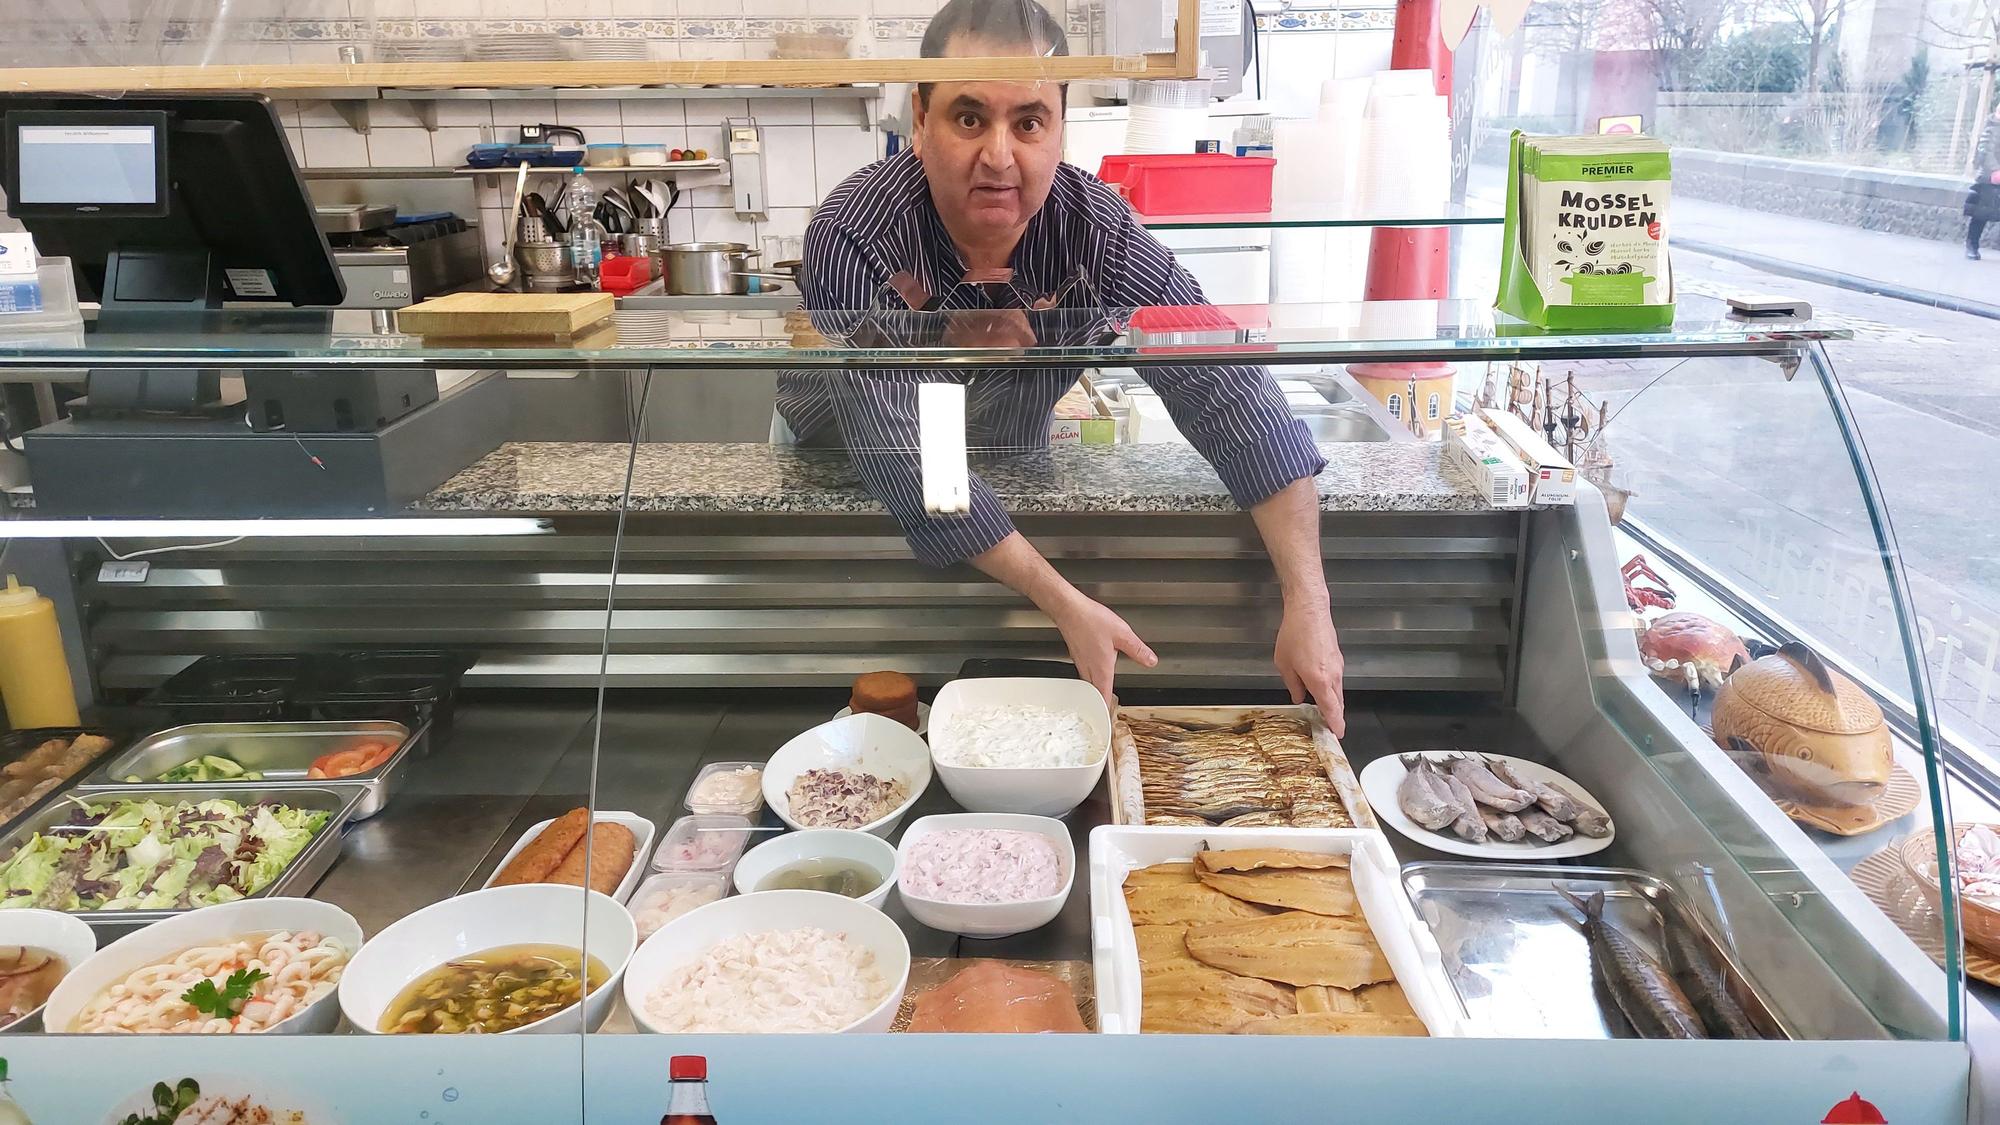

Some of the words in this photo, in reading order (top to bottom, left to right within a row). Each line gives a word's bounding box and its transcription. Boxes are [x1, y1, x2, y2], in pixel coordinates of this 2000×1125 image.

[1581, 165, 1634, 176] PREMIER
[1560, 190, 1654, 212] MOSSEL
[1558, 212, 1656, 230] KRUIDEN
[1051, 431, 1080, 441] PACLAN
